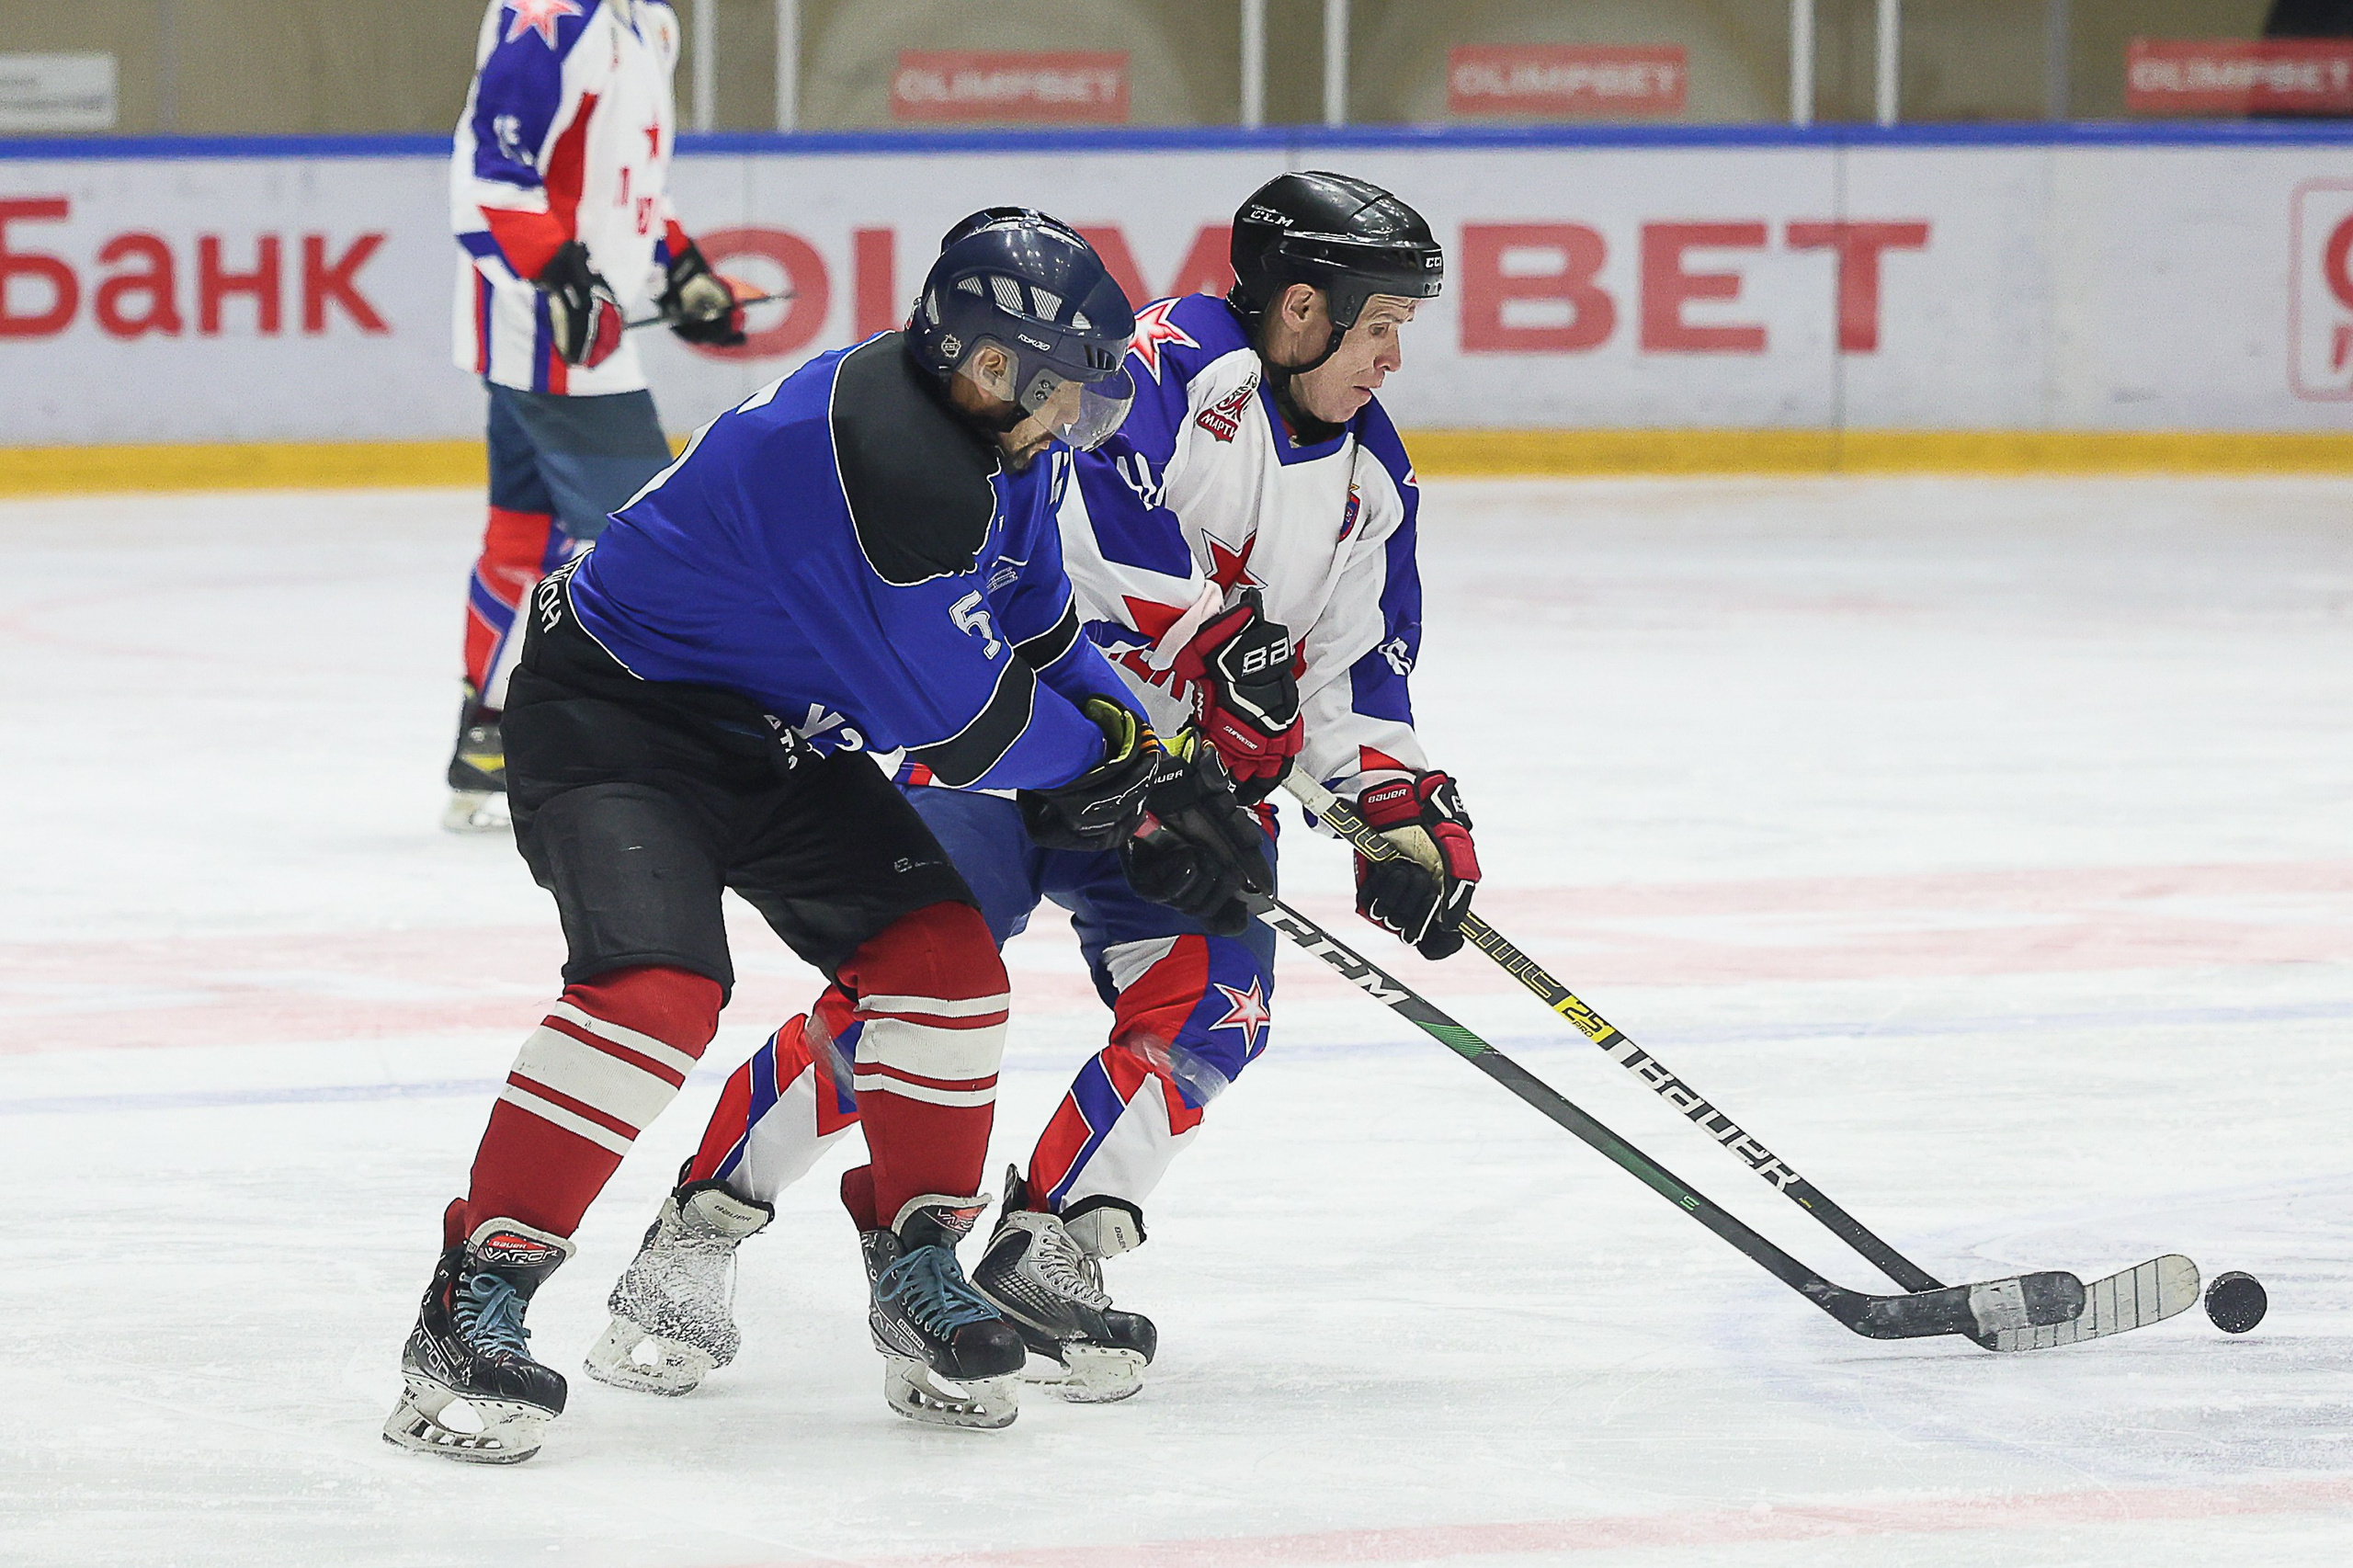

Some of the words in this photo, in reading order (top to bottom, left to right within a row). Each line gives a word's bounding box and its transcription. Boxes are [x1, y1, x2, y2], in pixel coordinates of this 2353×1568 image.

[1425, 256, 1443, 269] CC
[1154, 768, 1184, 785] UER
[1367, 788, 1407, 804] BAUER
[1256, 903, 1411, 1006] CCM
[1627, 1057, 1802, 1193] BAUER
[484, 1247, 559, 1263] VAPOR
